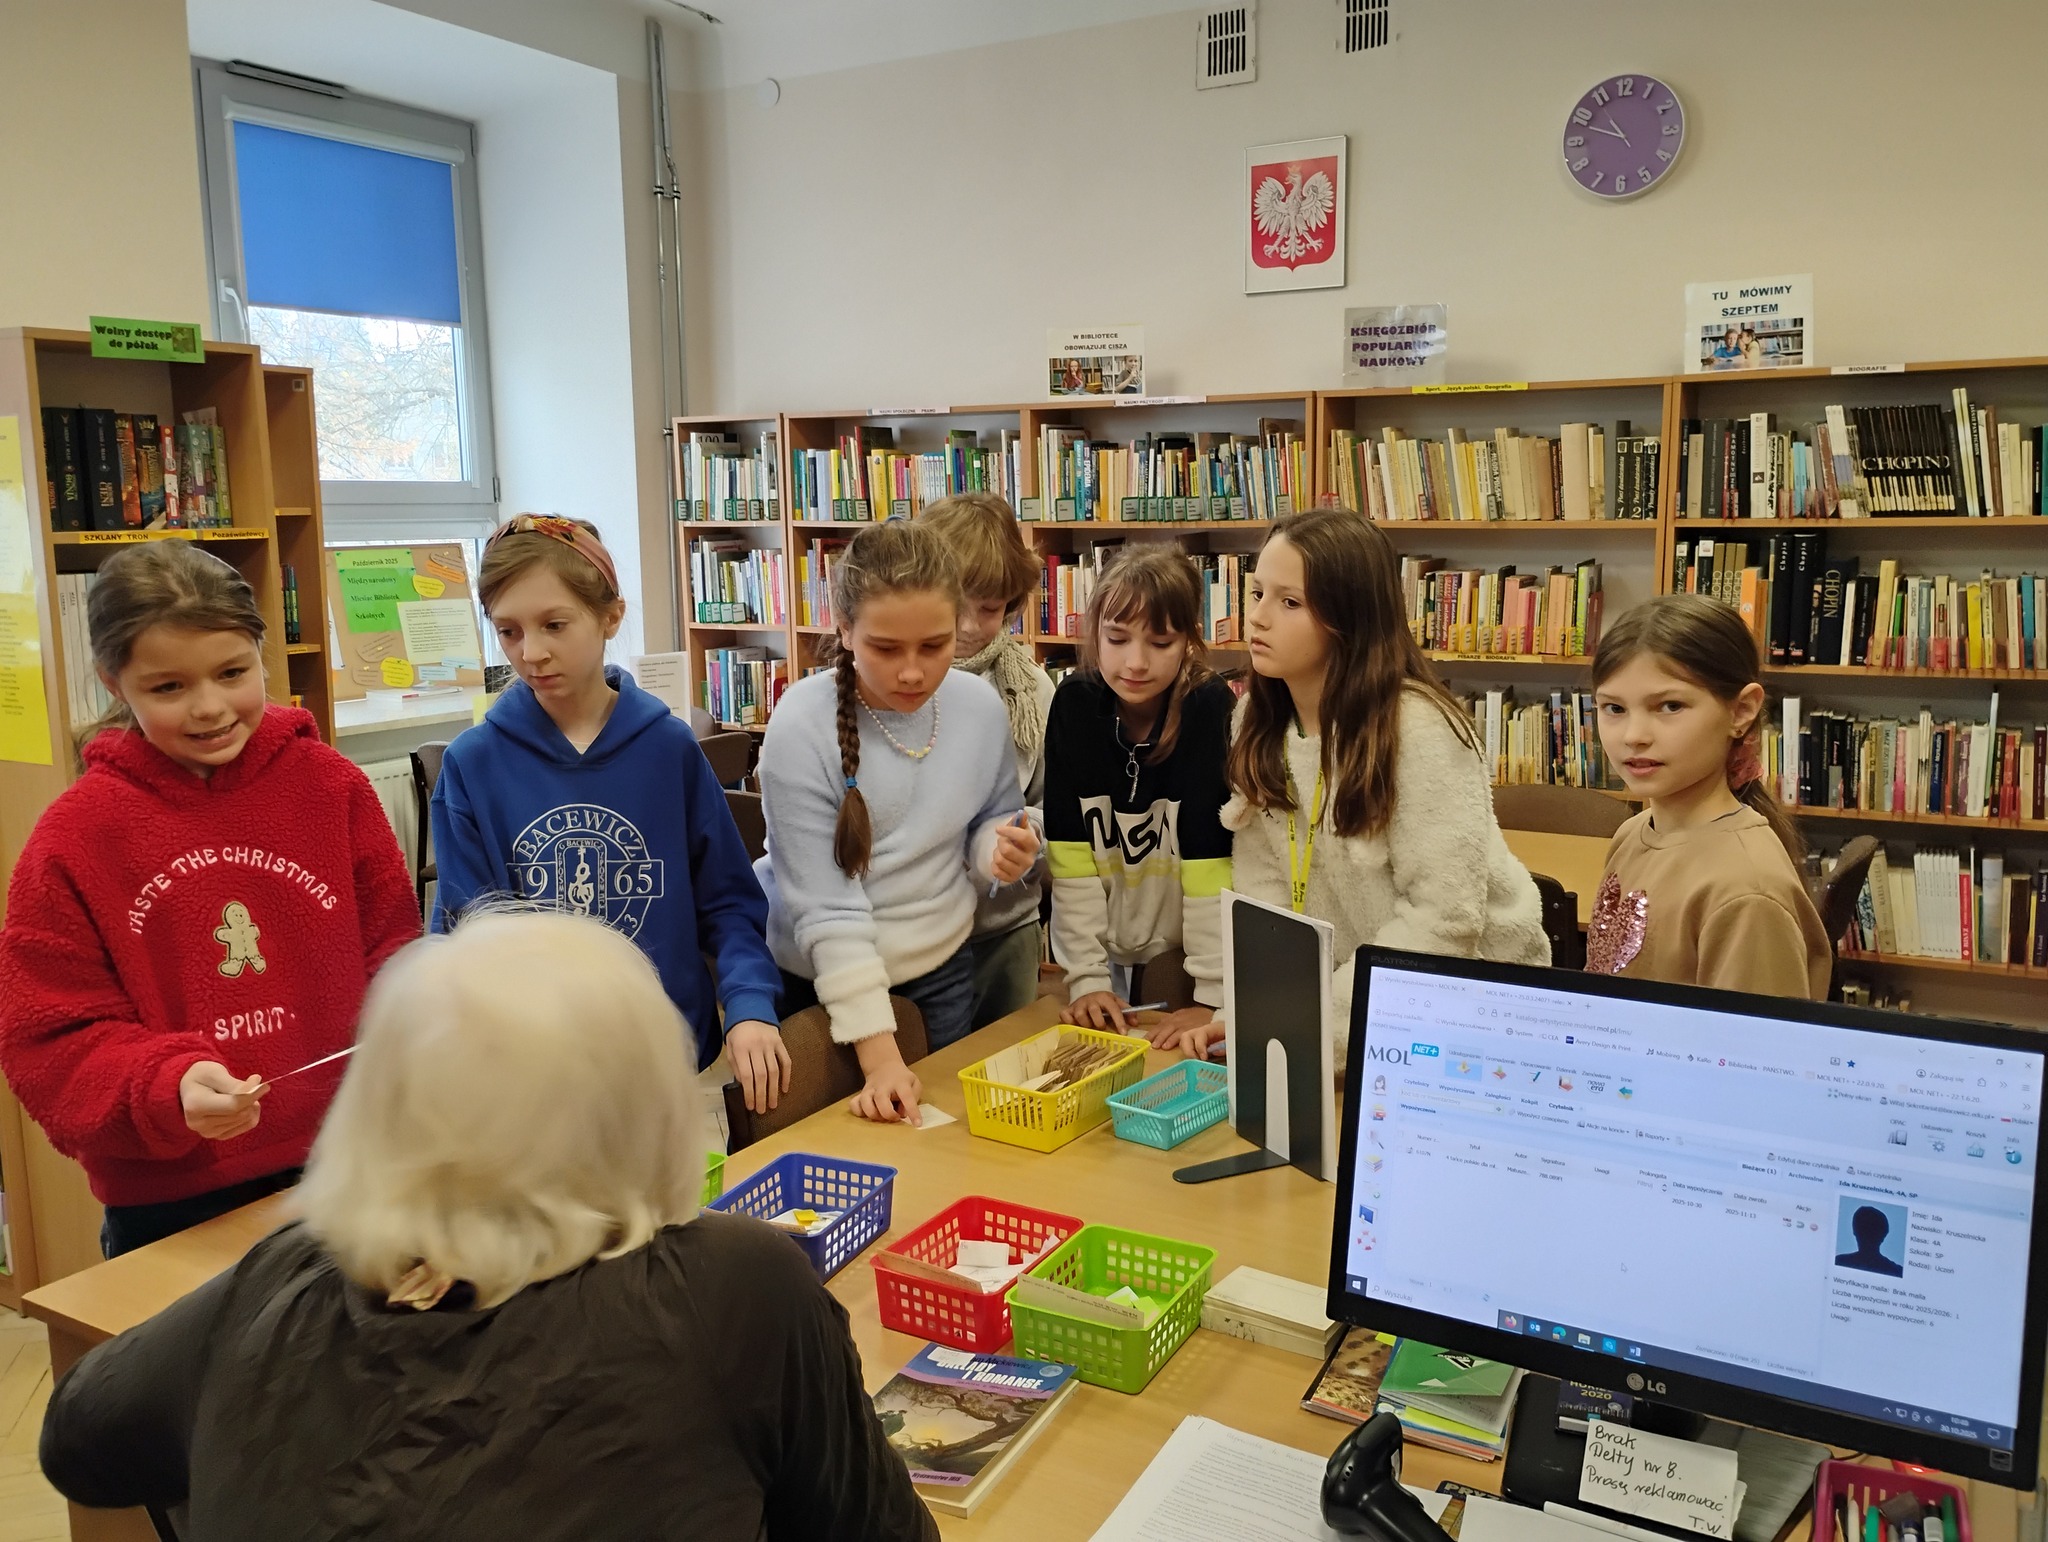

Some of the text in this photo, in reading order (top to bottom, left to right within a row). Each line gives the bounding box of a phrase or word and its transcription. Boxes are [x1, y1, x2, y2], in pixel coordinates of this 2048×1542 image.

[1616, 78, 1634, 97] 12
[1642, 82, 1655, 99] 1
[1591, 86, 1610, 106] 11
[1656, 99, 1674, 115] 2
[1572, 107, 1593, 126] 10
[1662, 124, 1680, 136] 3
[1566, 136, 1584, 147] 9
[1656, 149, 1672, 162] 4
[1572, 157, 1589, 172] 8
[1591, 171, 1605, 188] 7
[1637, 166, 1652, 183] 5
[1615, 175, 1626, 192] 6
[1712, 285, 1793, 301] TU MÓWIMY
[1721, 303, 1779, 317] SZEPTEM
[94, 325, 172, 341] Wolny dostęp
[1351, 322, 1437, 337] KSIĘGOZBIÓR
[109, 339, 159, 351] do półek
[1359, 356, 1426, 368] NAUKOWY
[1633, 507, 1642, 518] 2
[84, 533, 149, 542] SZKLANY TRON
[212, 531, 265, 539] Pozaświatowcy
[352, 558, 385, 567] Październik
[1779, 542, 1789, 571] Chopin
[1798, 542, 1808, 572] Chopin
[347, 576, 398, 586] Międzynarodowy
[1823, 569, 1842, 618] CHOPIN
[356, 612, 386, 621] Szkolnych
[516, 809, 643, 861] BACEWICZ
[566, 840, 604, 850] BACEWICZ
[514, 865, 549, 899] 19
[613, 863, 653, 895] 65
[128, 846, 338, 934] TASTE THE CHRISTMAS
[623, 913, 638, 929] 3
[1575, 1038, 1611, 1050] Avery Design
[1367, 1044, 1438, 1067] MOL NET+
[1656, 1050, 1681, 1061] Mobireg
[1728, 1060, 1757, 1071] Biblioteka
[1581, 1070, 1612, 1080] Zamówienia
[1816, 1073, 1832, 1082] MOL
[1929, 1072, 1954, 1083] Zaloguj
[1403, 1078, 1430, 1089] Czytelnicy
[1438, 1084, 1476, 1095] Wypożyczenia
[1590, 1084, 1605, 1093] era
[1909, 1086, 1925, 1096] MOL
[1520, 1097, 1539, 1106] Kokpit
[1548, 1102, 1575, 1112] Czytelnik
[1400, 1103, 1437, 1115] Wypożyczenia
[1585, 1122, 1601, 1131] Akcje
[1965, 1129, 1987, 1140] Koszyk
[1514, 1151, 1528, 1160] Autor
[1777, 1154, 1840, 1173] Edytuj czytelnika
[1594, 1167, 1611, 1176] Uwagi
[1638, 1169, 1668, 1181] Prolongata
[1766, 1167, 1777, 1176] (1)
[1787, 1171, 1824, 1183] Archiwalne
[1672, 1181, 1687, 1190] Data
[1838, 1180, 1851, 1188] Ida
[1851, 1182, 1895, 1197] Kruszelnicka,
[1912, 1211, 1943, 1223] Imię: Ida
[1911, 1223, 1987, 1243] Nazwisko: Kruszelnicka
[1910, 1236, 1942, 1247] Klasa: 4A
[1909, 1247, 1932, 1258] Szkoła:
[1908, 1260, 1955, 1275] Rodzaj: Uczeń
[1833, 1276, 1870, 1291] Weryfikacja
[1892, 1288, 1907, 1297] Brak
[1908, 1292, 1927, 1301] maila
[1384, 1288, 1413, 1303] Wyszukaj
[1832, 1288, 1953, 1319] Liczba wypożyczeń roku 2025/2026:
[1830, 1312, 1851, 1323] Uwagi:
[1831, 1300, 1851, 1310] Liczba
[1852, 1305, 1886, 1318] wszystkich
[1886, 1312, 1927, 1327] wypożyczeń:
[985, 1356, 1034, 1370] Mickiewicz
[961, 1370, 970, 1380] I
[971, 1370, 1045, 1390] ROMANSE
[1646, 1379, 1667, 1395] LG
[1580, 1389, 1613, 1401] 2020
[1594, 1424, 1637, 1450] Brak
[1588, 1441, 1635, 1477] Delty
[1644, 1459, 1662, 1474] nr
